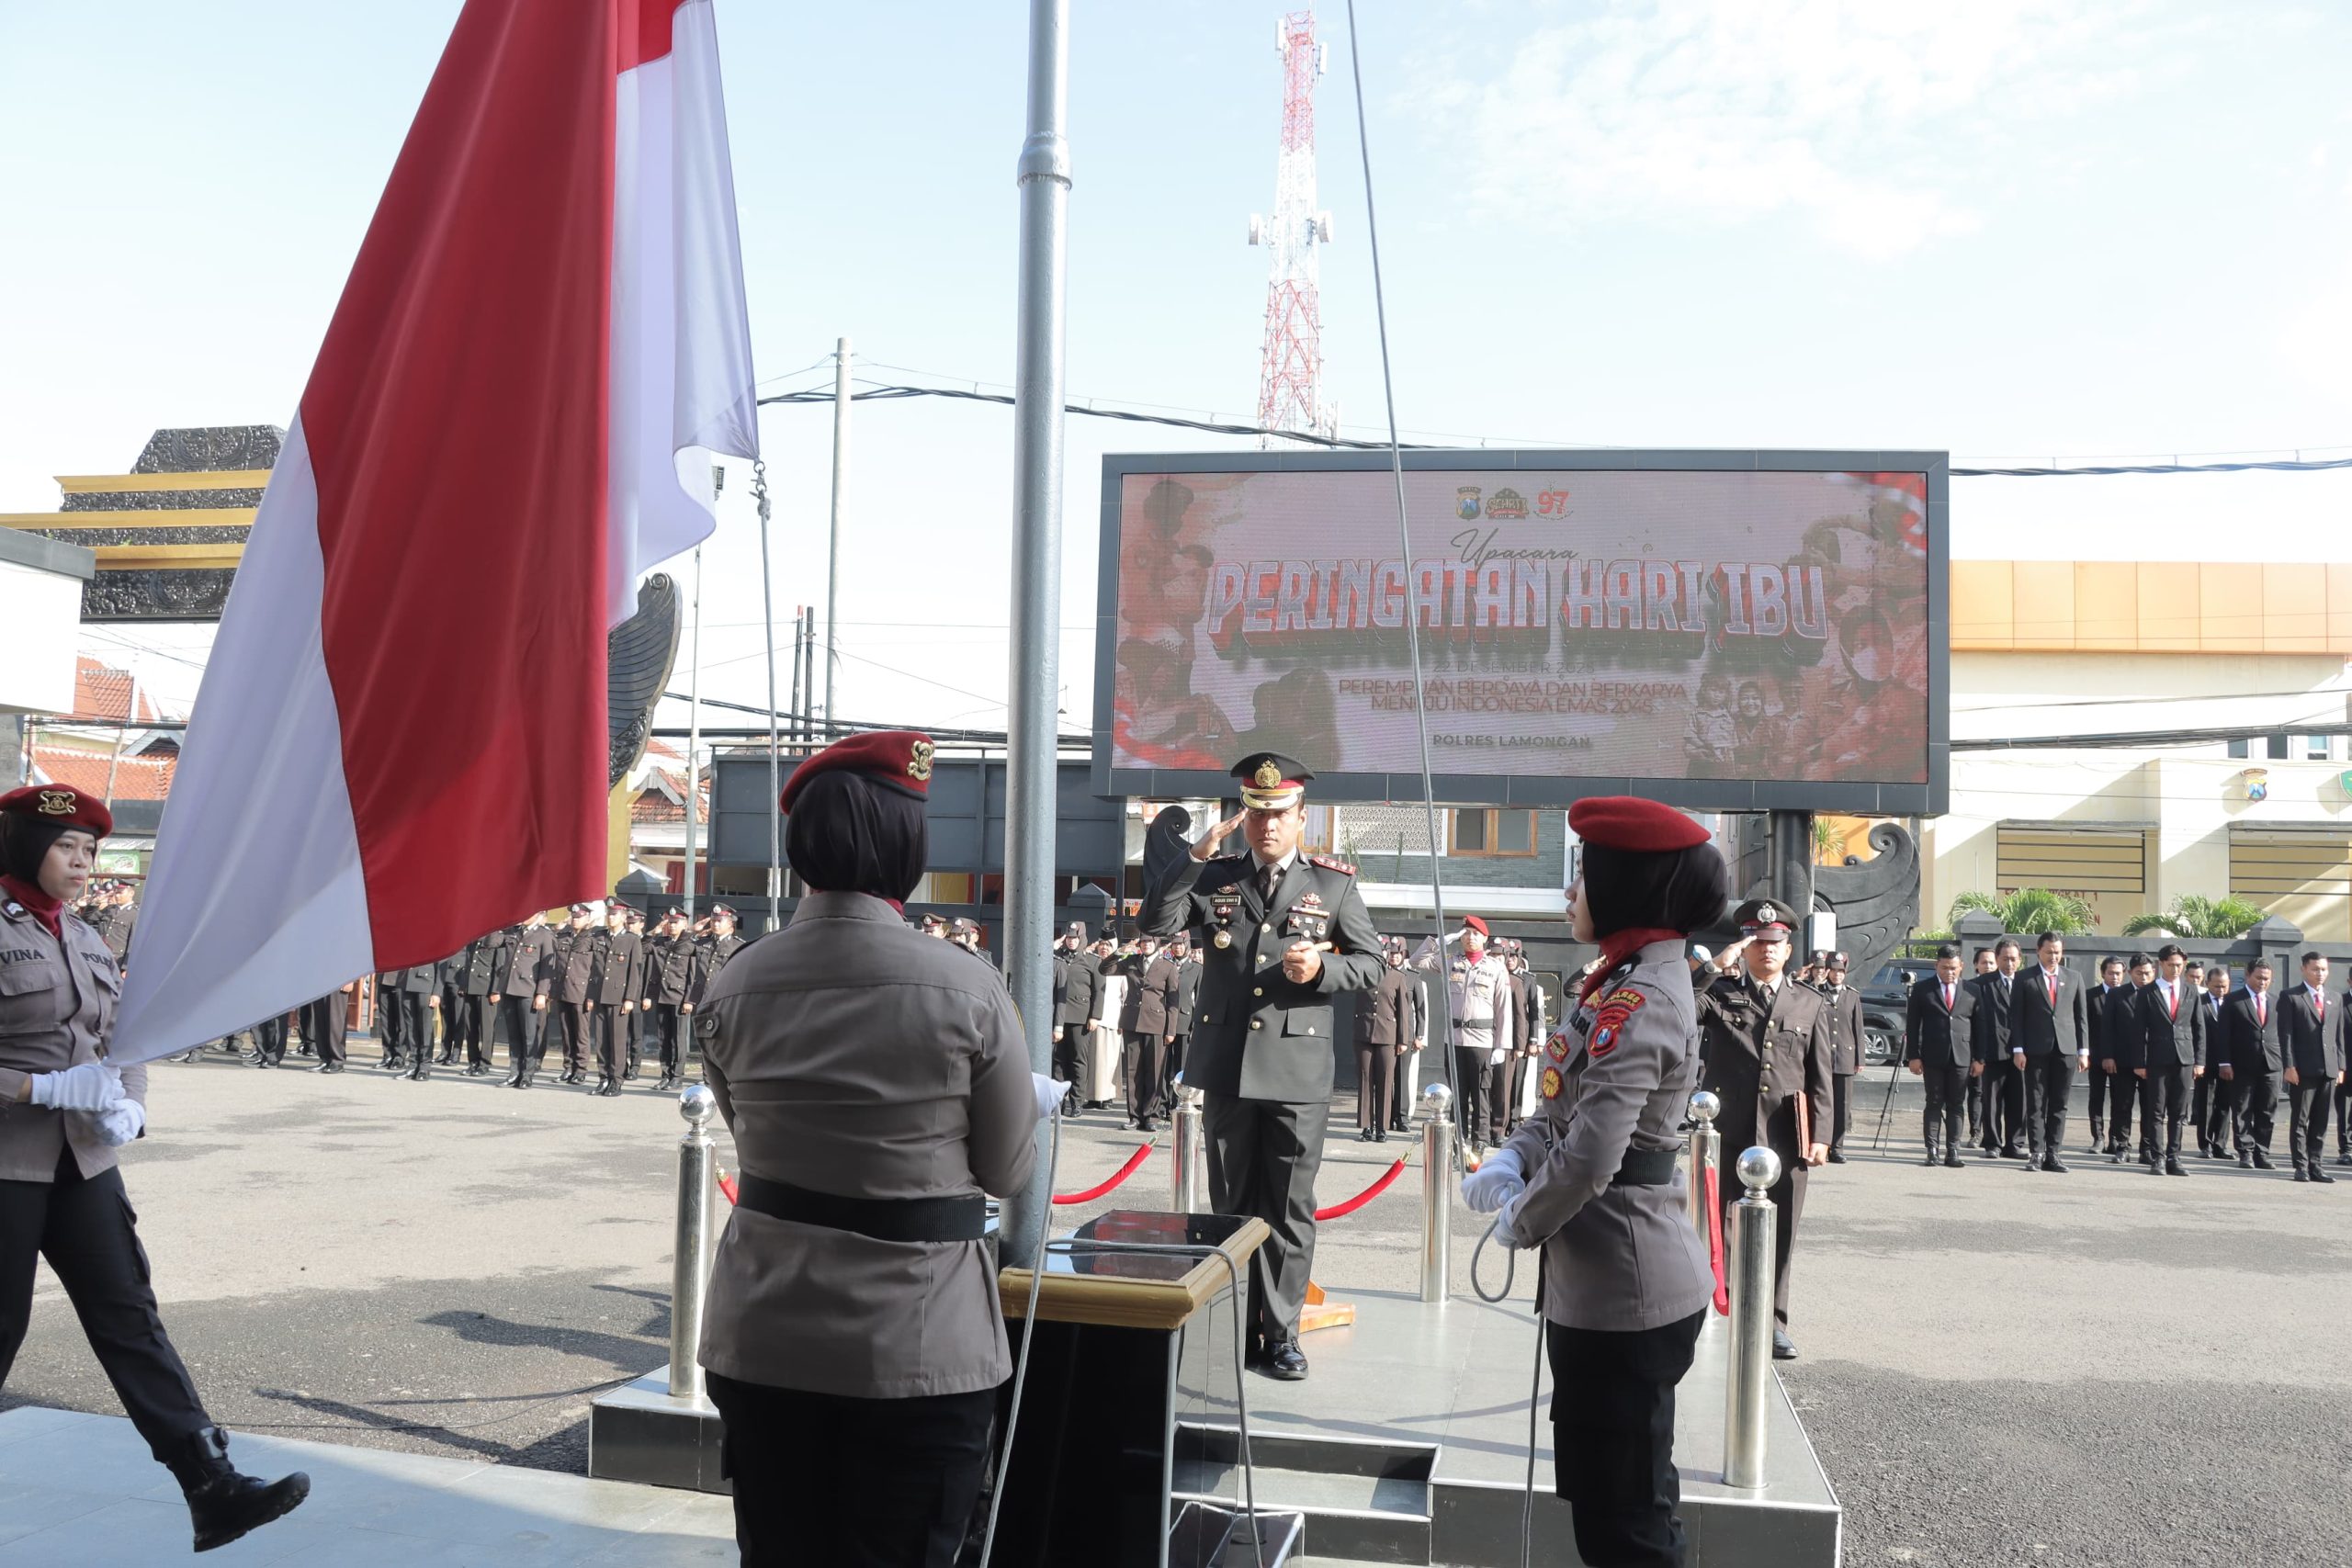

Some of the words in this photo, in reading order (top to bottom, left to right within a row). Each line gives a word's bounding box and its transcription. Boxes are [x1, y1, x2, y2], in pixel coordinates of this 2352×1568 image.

[1538, 490, 1569, 514] 97
[1450, 527, 1578, 571] Upacara
[1207, 558, 1550, 639] PERINGATAN
[1564, 558, 1706, 634] HARI
[1716, 561, 1828, 640] IBU
[1432, 660, 1451, 672] 22
[1339, 679, 1453, 695] PEREMPAN
[1457, 680, 1543, 696] BERDAYA
[1545, 682, 1586, 697] DAN
[1590, 682, 1687, 699] BERKARYA
[1452, 696, 1553, 713] INDONESIA
[1556, 698, 1612, 714] EMAS
[1432, 735, 1494, 746] POLRES
[1498, 736, 1591, 749] LAMONGAN
